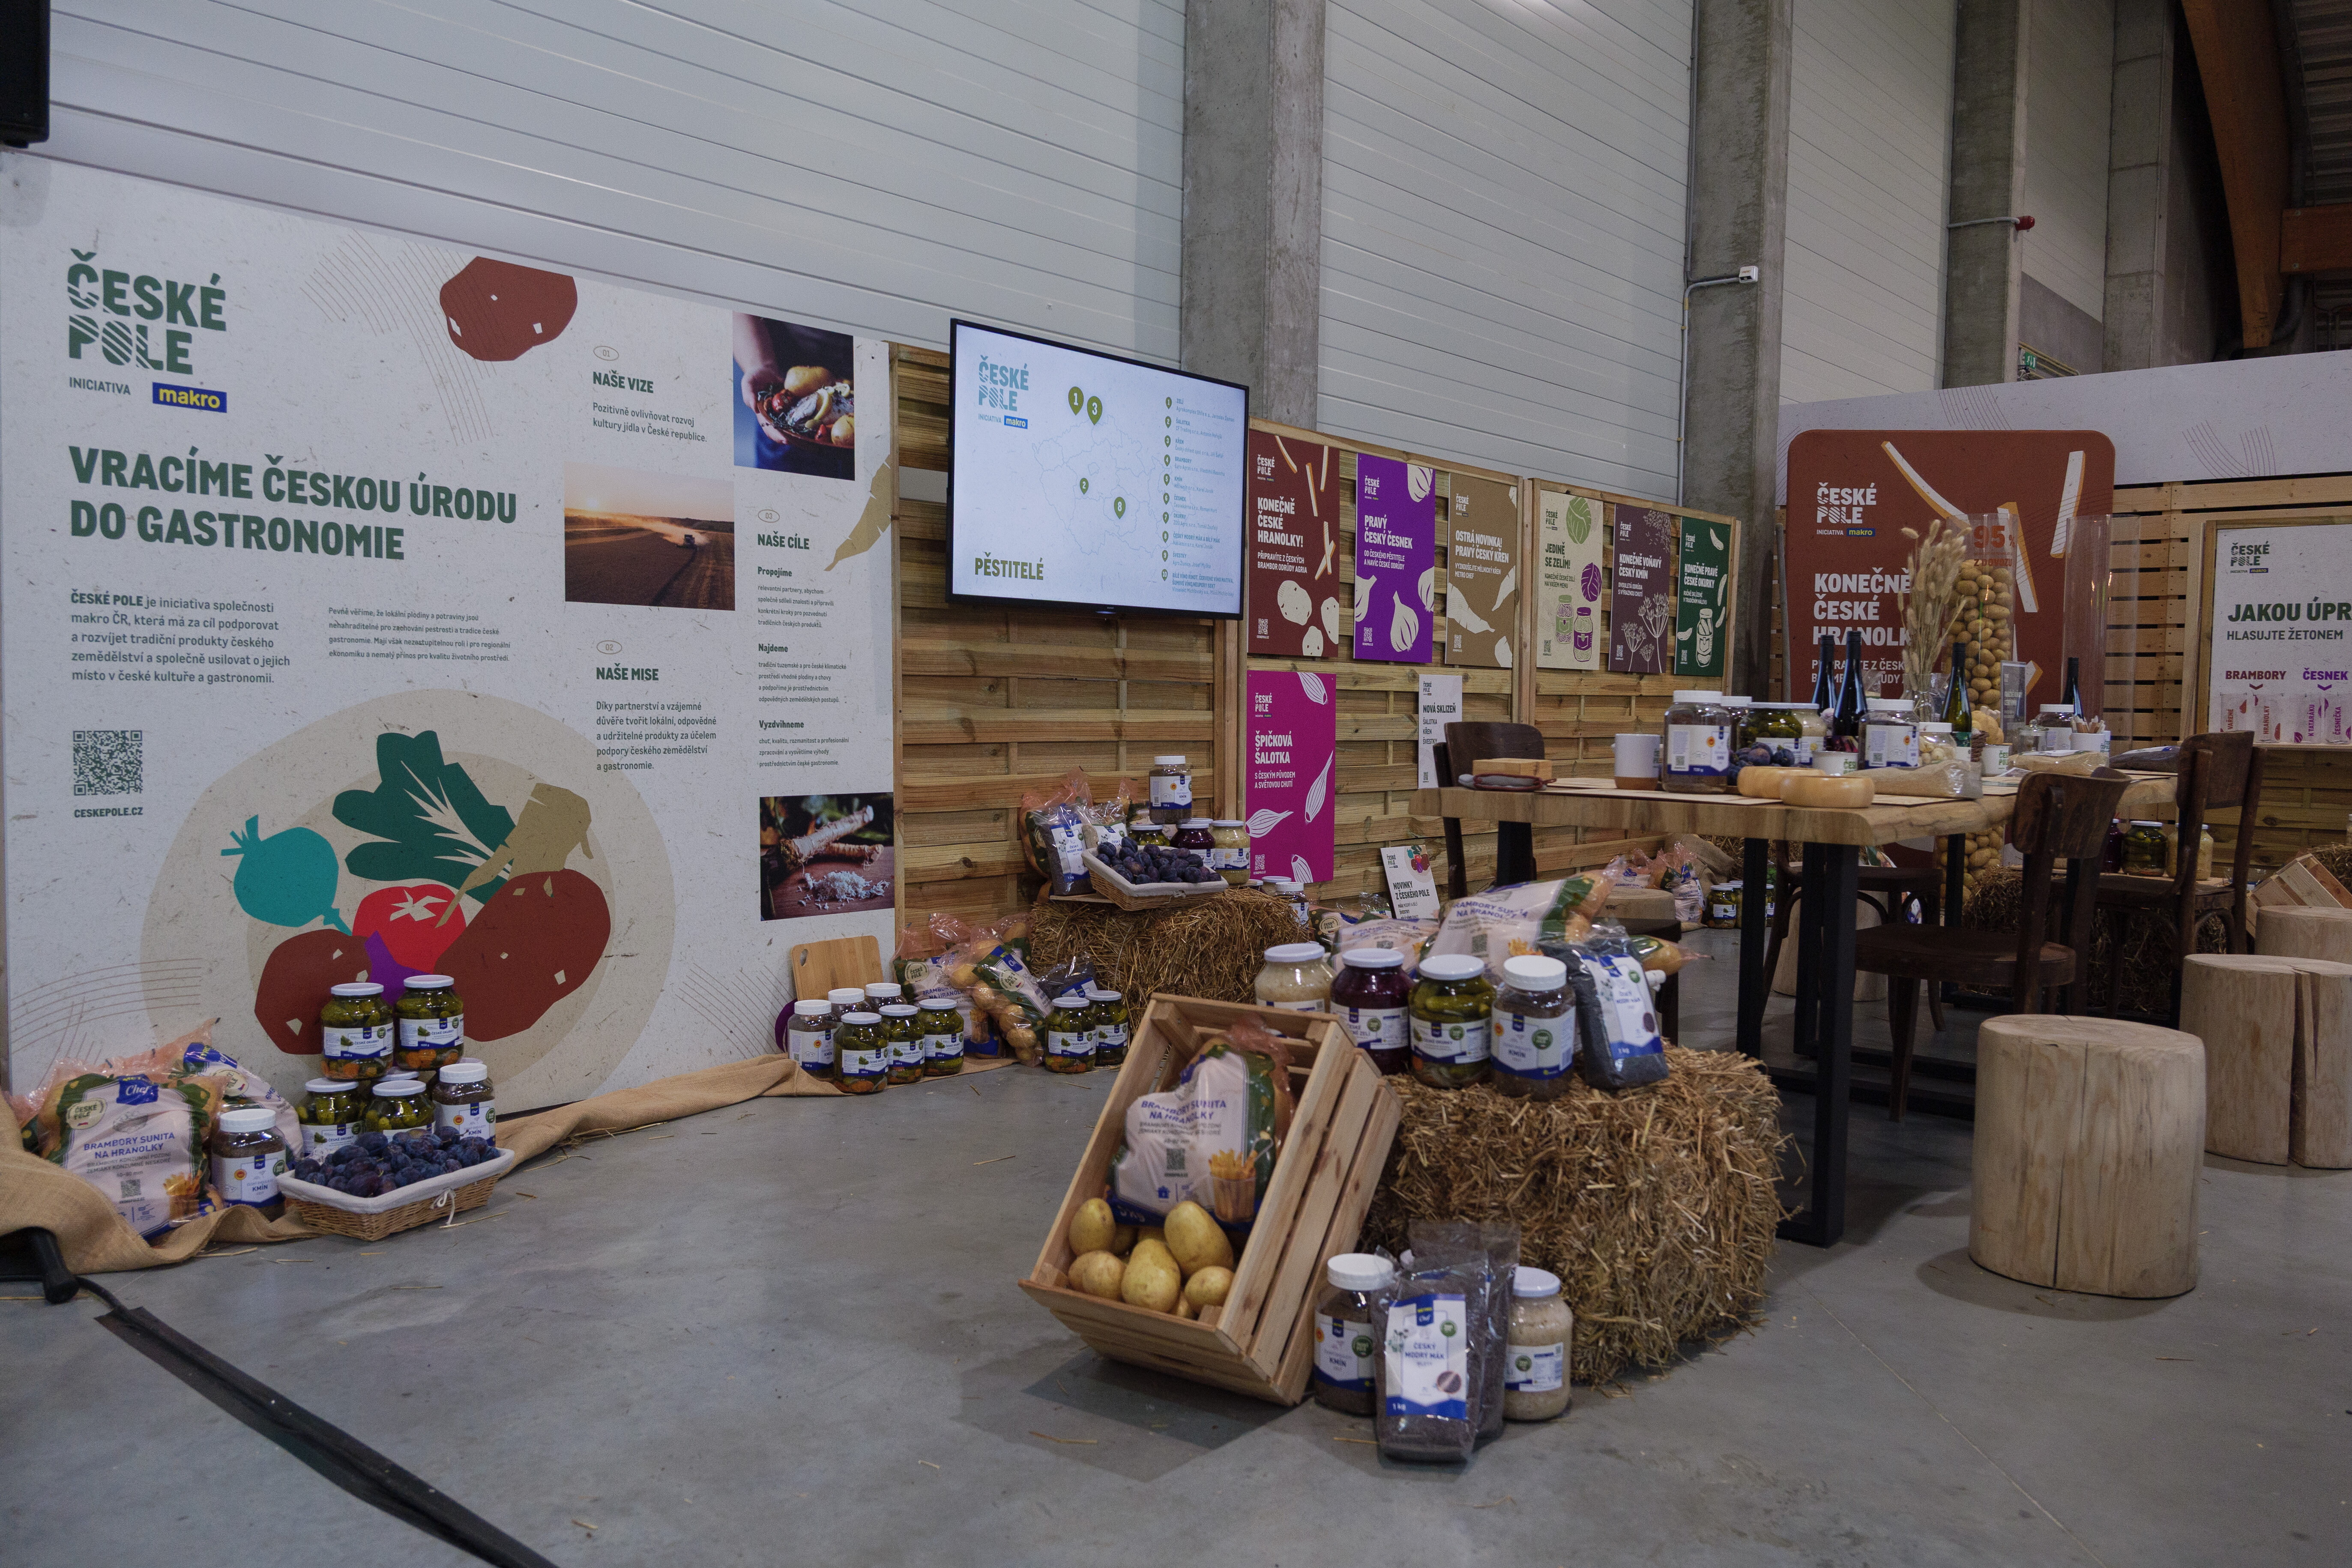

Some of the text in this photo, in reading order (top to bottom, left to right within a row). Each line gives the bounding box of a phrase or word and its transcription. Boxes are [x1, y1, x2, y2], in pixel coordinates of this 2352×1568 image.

[67, 248, 227, 331] ČESKÉ
[68, 314, 193, 374] POLE
[979, 355, 1029, 390] ČESKÉ
[69, 377, 131, 396] INICIATIVA
[593, 369, 653, 393] NAŠE VIZE
[159, 386, 221, 409] makro
[979, 386, 1017, 412] POLE
[1073, 393, 1078, 405] 1
[593, 402, 694, 427] Pozitivně ovlivňovat rozvoj
[1092, 403, 1098, 415] 3
[979, 413, 1026, 428] INICIATIVA makro
[1176, 418, 1190, 426] ŠALOTKA
[593, 418, 622, 431] kultury
[622, 422, 639, 432] jídla
[648, 423, 669, 437] České
[671, 430, 707, 442] republice.
[1257, 454, 1275, 467] ČESKÉ
[1257, 466, 1271, 476] POLE
[69, 445, 516, 523] VRACÍME ČESKOU ÚRODU
[1365, 476, 1379, 488] ČESKÉ
[1365, 486, 1376, 495] POLE
[1817, 482, 1877, 505] ČESKÉ
[1117, 502, 1122, 511] 8
[1257, 496, 1295, 514] KONEČNĚ
[1257, 510, 1283, 530] ČESKÉ
[1365, 514, 1387, 529] PRAVÝ
[1817, 506, 1863, 524] POLE
[71, 500, 404, 559] DO GASTRONOMIE
[1974, 525, 2005, 548] 95
[757, 531, 809, 550] NAŠE CÍLE
[1257, 530, 1303, 548] HRANOLKY!
[1365, 527, 1412, 549] ČESKÝ ČESNEK
[1456, 529, 1502, 548] OSTRÁ NOVINKA!
[1456, 545, 1509, 563] PRAVÝ ČESKÝ KŘEN
[1546, 542, 1565, 554] JEDINĚ
[2231, 541, 2270, 556] ČESKÉ
[1257, 550, 1282, 561] PŘIPRAVÍTE
[1286, 554, 1304, 564] ČESKÝCH
[1545, 556, 1570, 569] SE ZELÍM!
[1619, 552, 1661, 568] KONEČNĚ VOŇAVÝ
[2230, 556, 2260, 567] POLE
[758, 566, 792, 578] Propojíme
[975, 552, 1044, 580] PĚSTITELÉ
[1257, 561, 1278, 570] BRAMBOR
[1278, 563, 1295, 572] ODRŮDY
[1619, 563, 1648, 579] ČESKÝ KMÍN
[1685, 562, 1718, 577] KONEČNĚ PRAVÉ
[1684, 573, 1715, 588] ČESKÉ OKURKY
[1815, 567, 1911, 593] KONEČNĚ
[71, 589, 273, 613] ČESKÉ POLE je iniciativa společnosti
[1814, 593, 1880, 620] ČESKÉ
[2228, 596, 2352, 622] JAKOU ÚPR
[72, 610, 278, 631] makro ČR, která má za cíl podporovat
[1813, 626, 1911, 646] HRANOLK
[2227, 627, 2343, 640] HLASUJTE ŽETONEM
[758, 644, 788, 653] Najdeme
[596, 663, 658, 681] NAŠE MISE
[2226, 670, 2286, 680] BRAMBORY
[2303, 667, 2348, 680] ČESNEK
[1255, 693, 1272, 703] ČESKÉ
[1423, 702, 1456, 713] NOVÁ SKLIZEŇ
[759, 720, 804, 730] Vyzdvihneme
[2333, 706, 2341, 735] ČESNEČKA
[1255, 730, 1293, 747] ŠPIČKOVÁ
[1255, 748, 1290, 764] ŠALOTKA
[1258, 770, 1275, 779] ČESKÝM
[1276, 769, 1295, 778] PŮVODEM
[74, 807, 143, 817] CESKEPOLE.CZ
[1393, 881, 1412, 890] NOVINKY
[1398, 889, 1418, 900] ČESKÉHO
[126, 1084, 152, 1095] Chef
[75, 1103, 97, 1113] ČESKÉ
[84, 1132, 175, 1150] BRAMBORY SUNITA
[111, 1143, 164, 1157] HRANOLKY
